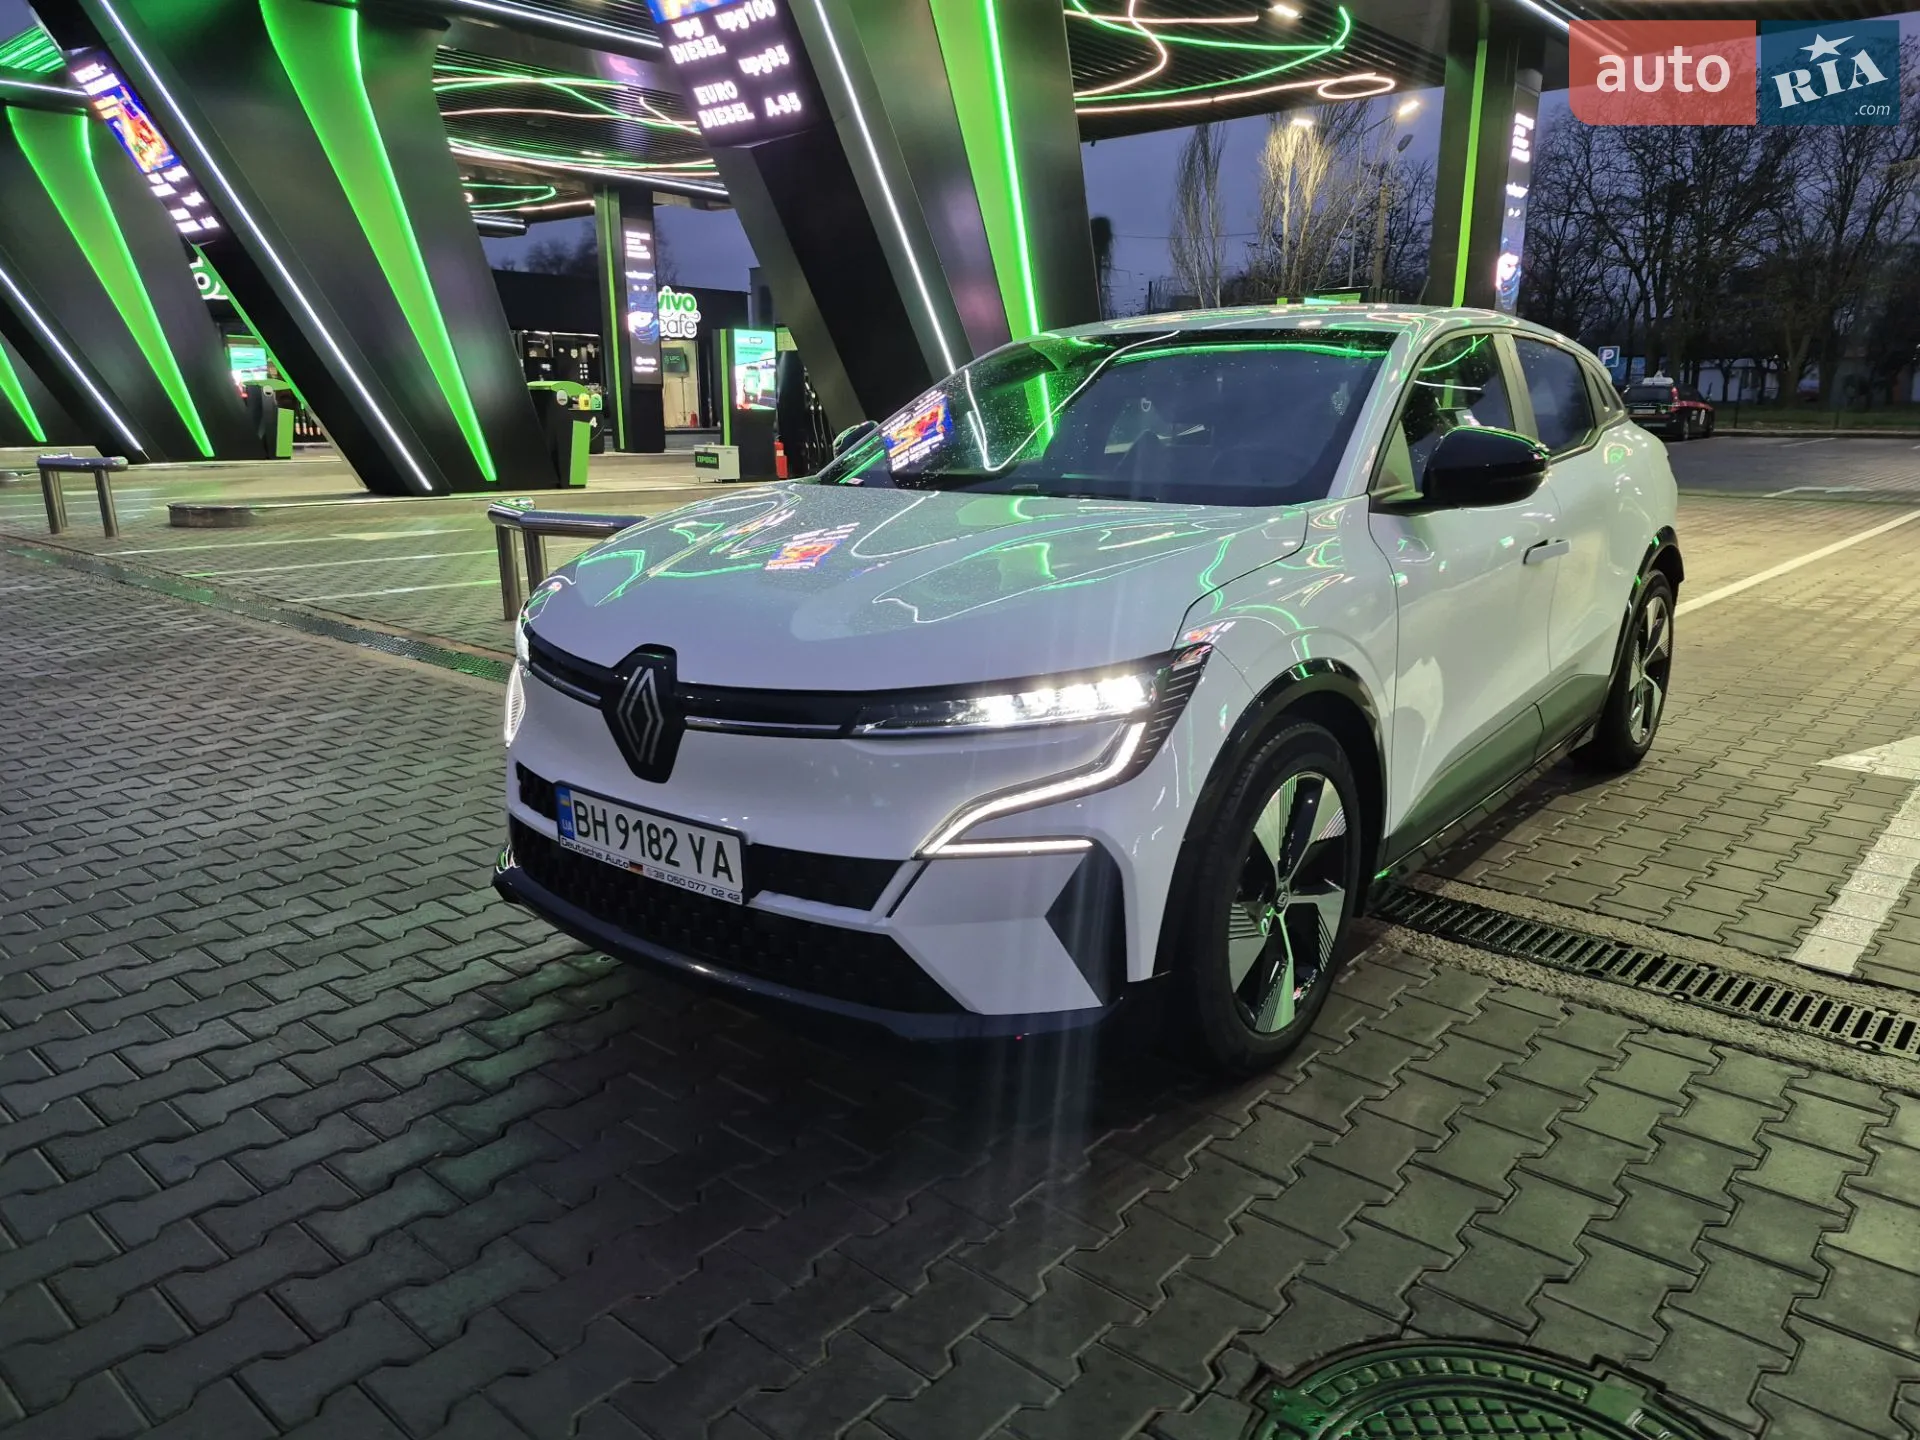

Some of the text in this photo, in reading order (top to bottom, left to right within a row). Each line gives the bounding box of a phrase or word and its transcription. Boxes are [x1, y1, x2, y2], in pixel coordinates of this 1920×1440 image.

[669, 34, 726, 65] DIESEL
[738, 44, 790, 76] upg95
[693, 80, 738, 106] EURO
[764, 92, 802, 117] A-95
[698, 102, 756, 129] DIESEL
[659, 289, 696, 312] vivo
[1602, 349, 1615, 365] P
[590, 416, 597, 428] 4
[561, 818, 573, 832] UA
[573, 799, 735, 883] BH 9182 YA
[561, 837, 603, 860] Deutsche
[605, 853, 629, 870] Auto
[687, 880, 707, 893] 077
[711, 887, 725, 899] 02
